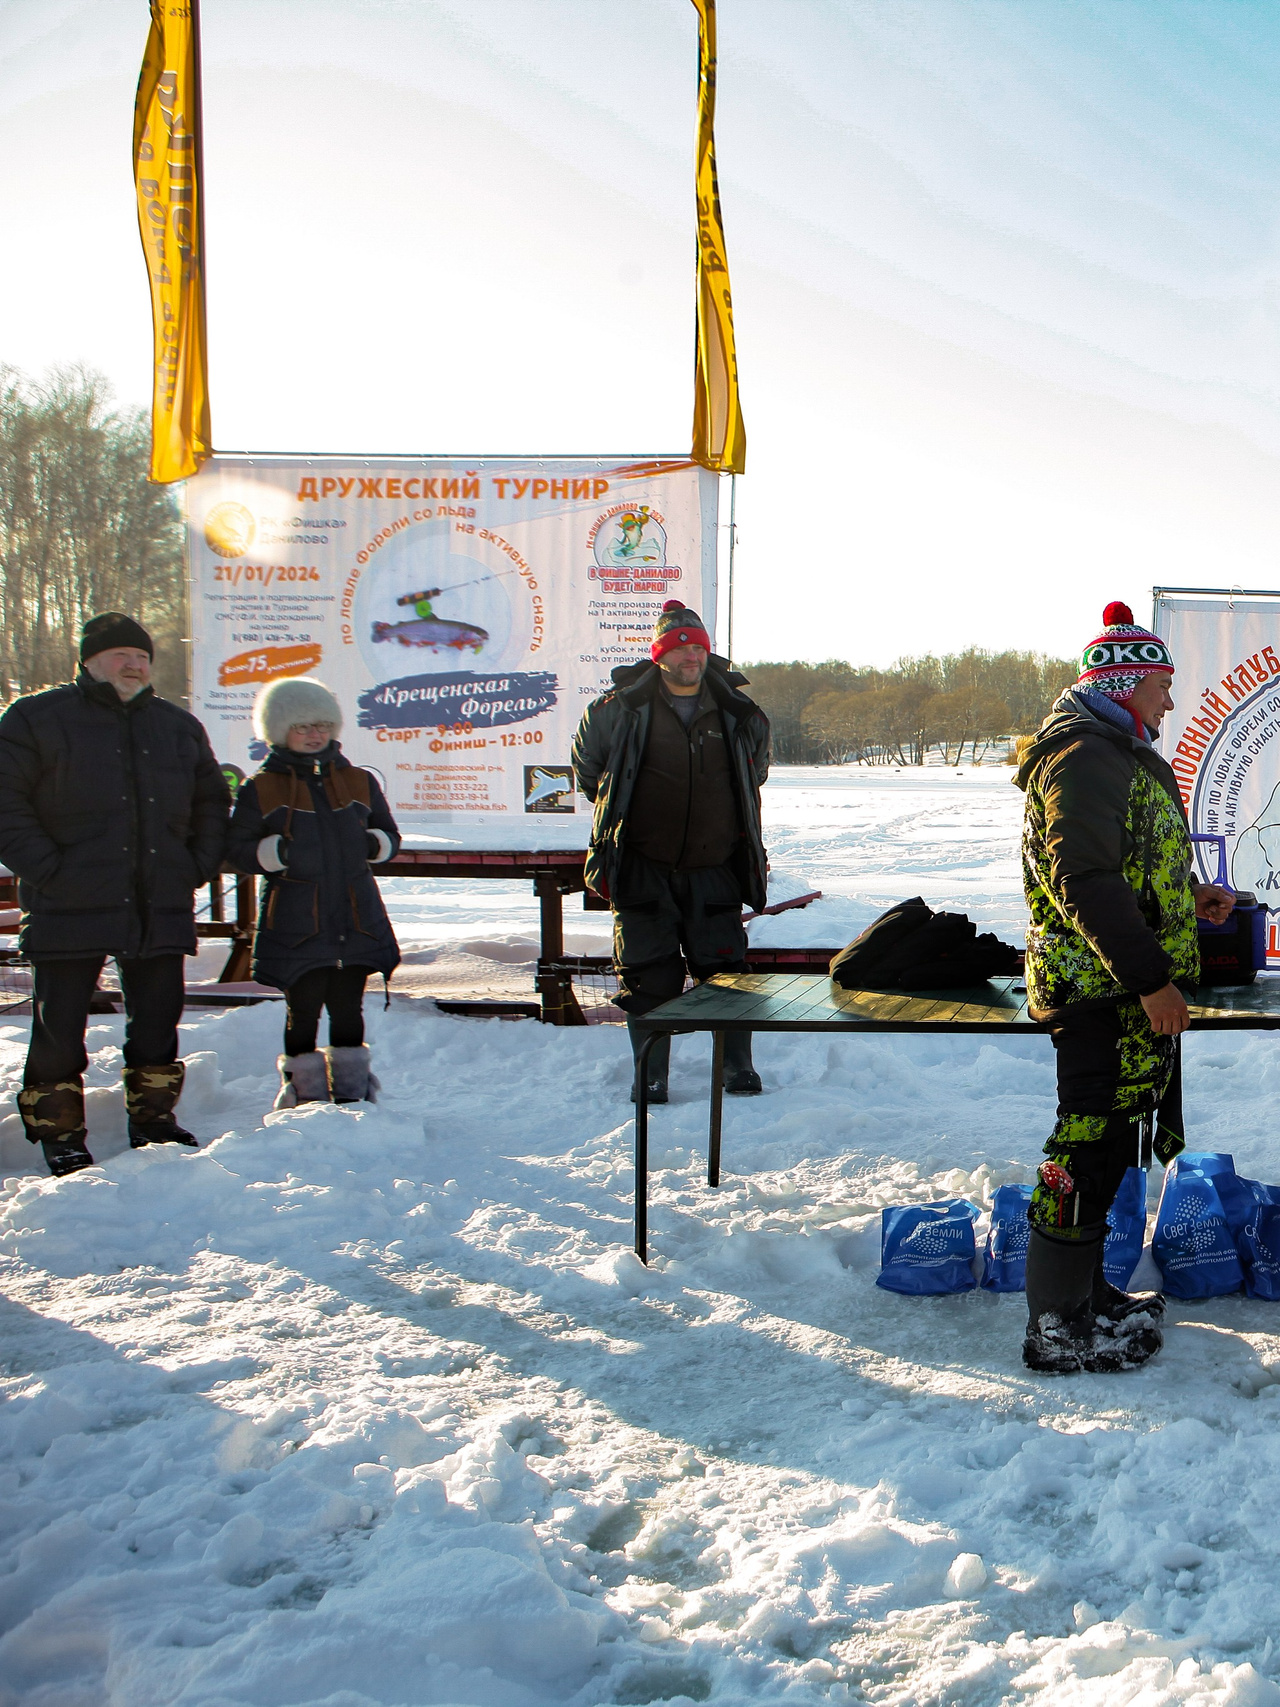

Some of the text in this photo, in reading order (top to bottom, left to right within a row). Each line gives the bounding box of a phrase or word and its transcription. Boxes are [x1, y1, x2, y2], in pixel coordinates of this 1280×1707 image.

[298, 470, 609, 502] ДРУЖЕСКИЙ ТУРНИР
[413, 508, 433, 522] со
[437, 504, 476, 519] льда
[213, 565, 320, 587] 21/01/2024
[340, 568, 361, 622] ловле
[455, 521, 545, 653] на активную снасть
[603, 581, 666, 592] БУДЕТ ЖАРКО!
[587, 600, 617, 608] Ловля
[606, 609, 650, 617] активную
[340, 624, 354, 645] по
[624, 635, 653, 643] место
[579, 654, 598, 663] 50%
[600, 645, 627, 654] кубок
[247, 654, 269, 673] 75
[374, 678, 511, 708] «Крещенская
[577, 686, 598, 695] 30%
[460, 695, 548, 719] Форель»
[376, 728, 422, 744] Старт
[437, 721, 473, 738] 9:00
[1230, 707, 1269, 750] ФОРЕЛИ
[428, 737, 487, 753] Финиш
[500, 730, 543, 747] 12:00
[434, 773, 478, 783] Данилово
[1214, 749, 1237, 788] ЛОВЛЕ
[1225, 754, 1254, 818] АКТИВНУЮ
[1208, 789, 1222, 806] ПО
[1224, 821, 1236, 837] НА
[1162, 1221, 1187, 1240] Свет
